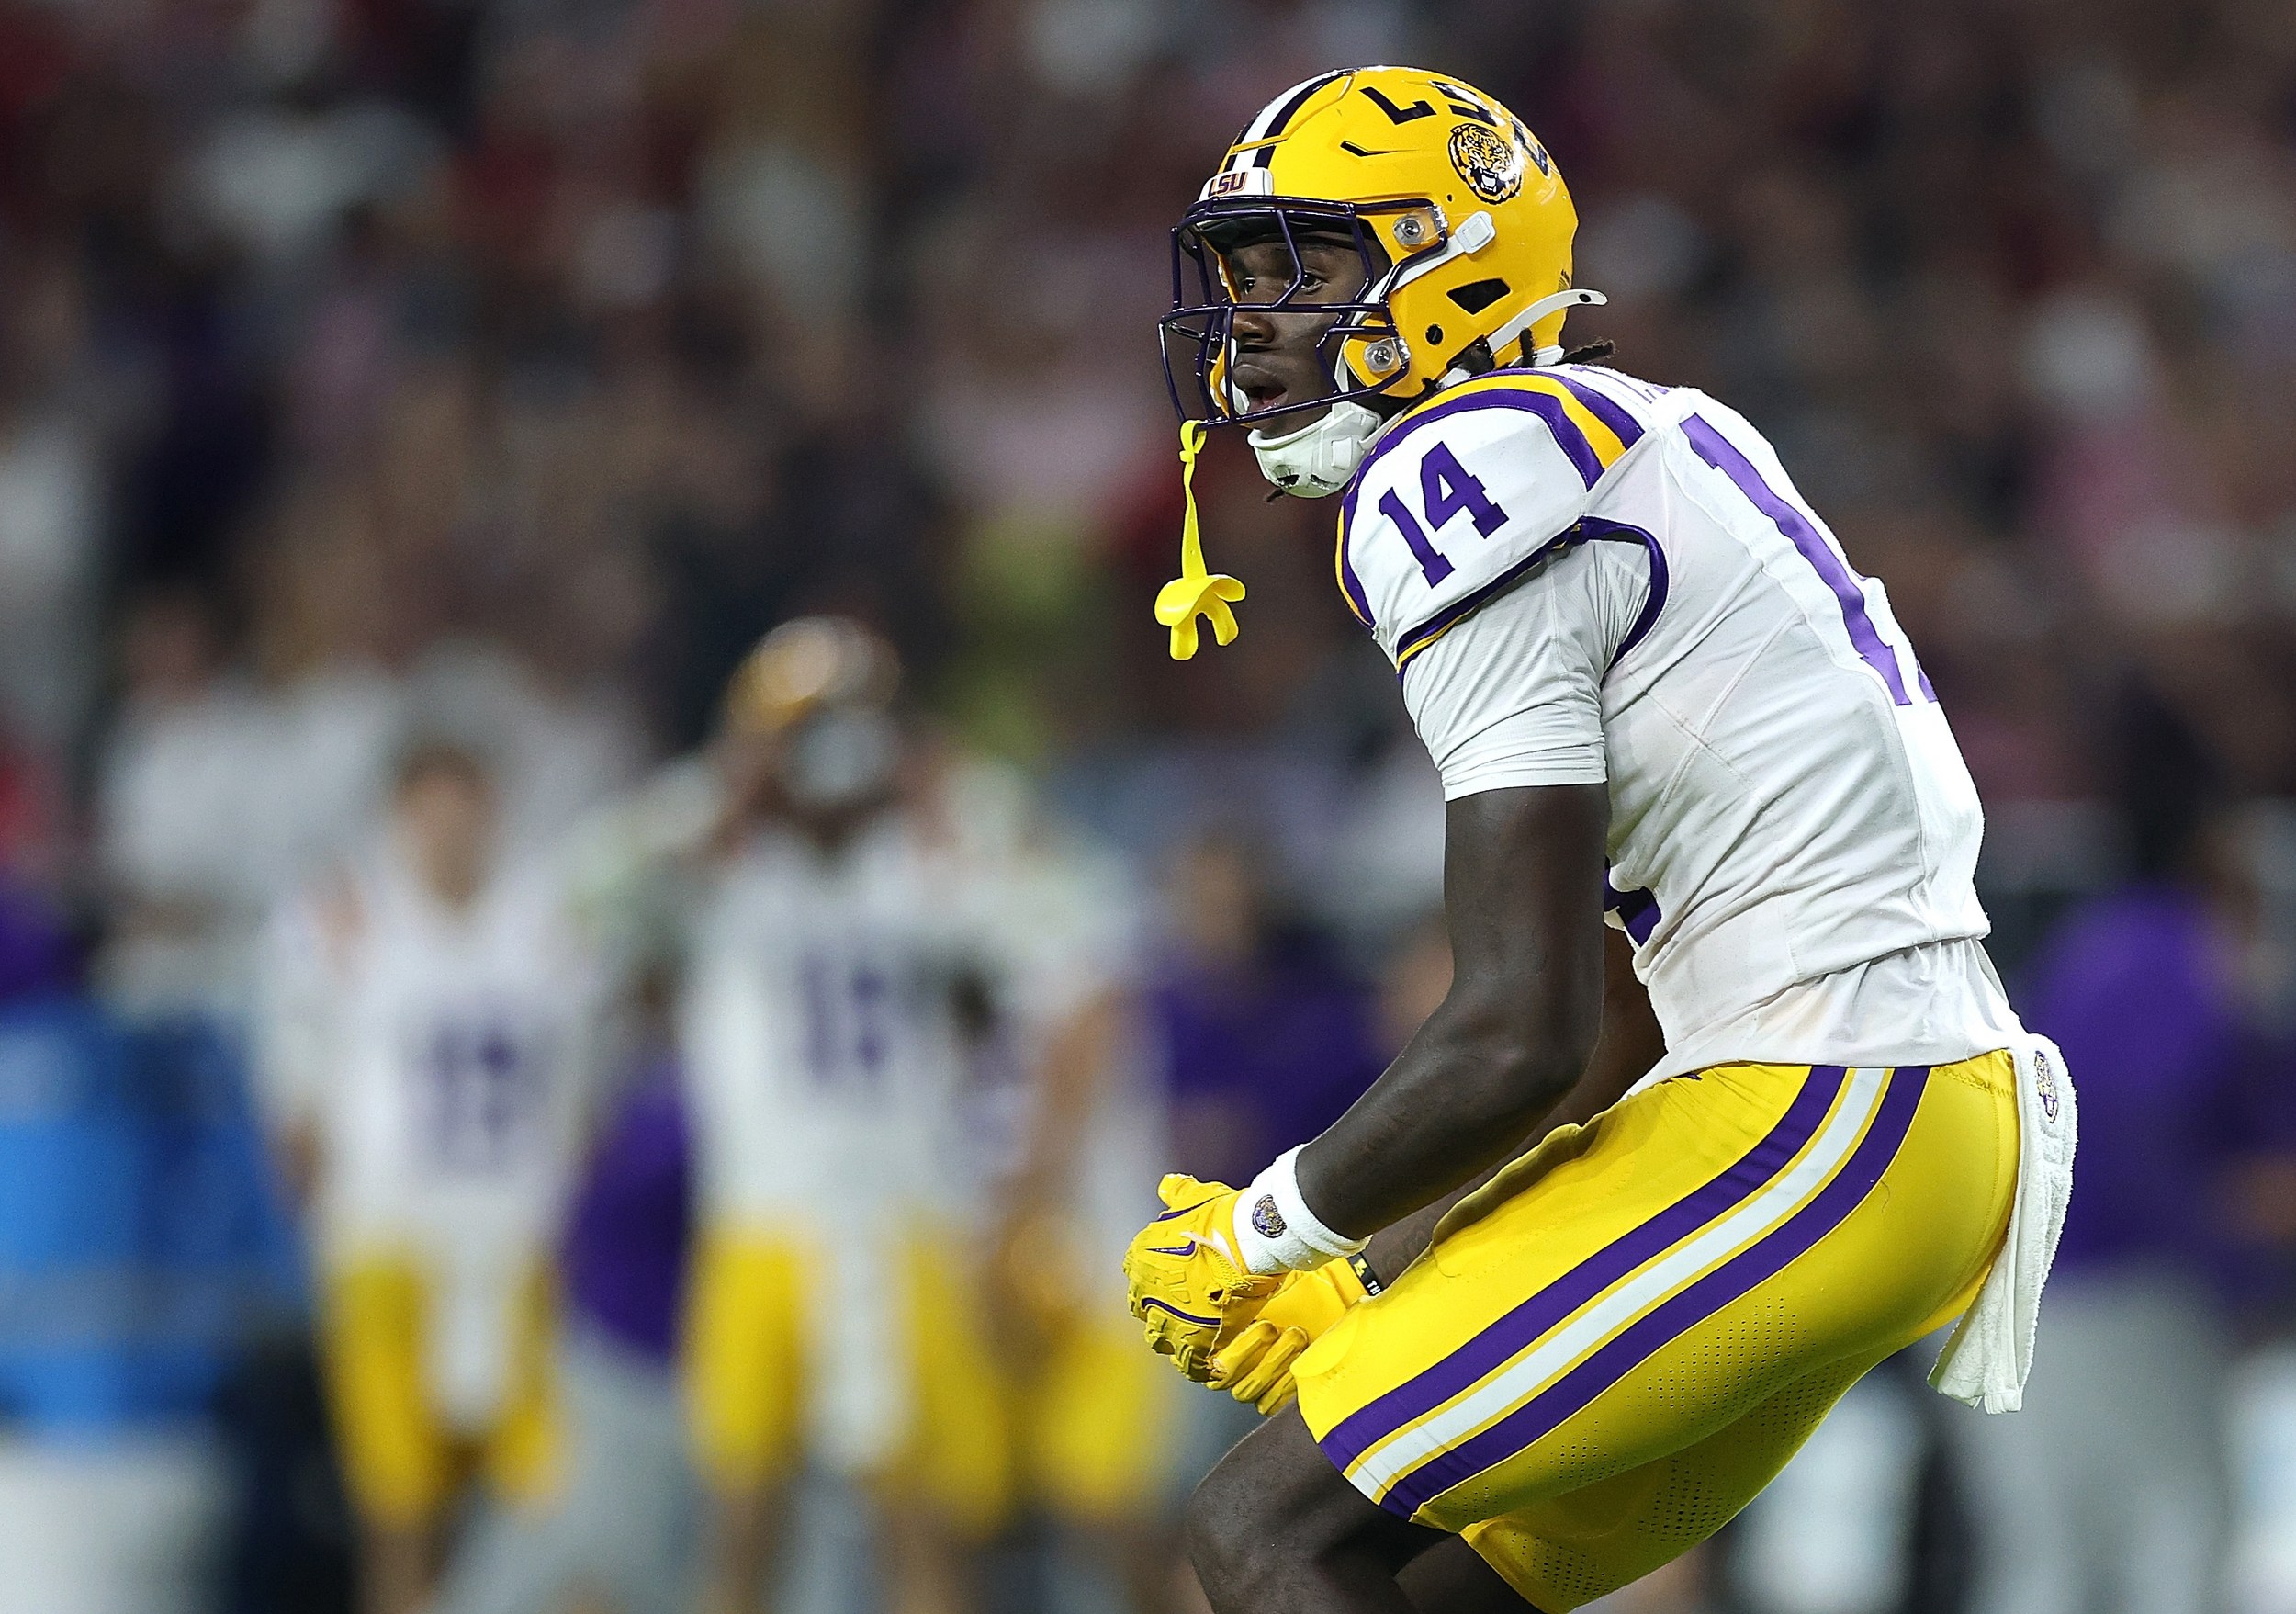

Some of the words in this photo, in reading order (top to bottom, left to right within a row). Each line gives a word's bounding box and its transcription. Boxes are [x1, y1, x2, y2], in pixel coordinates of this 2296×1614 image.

[1208, 172, 1248, 198] LSU
[1379, 440, 1509, 589] 14
[1679, 412, 1939, 706] 1
